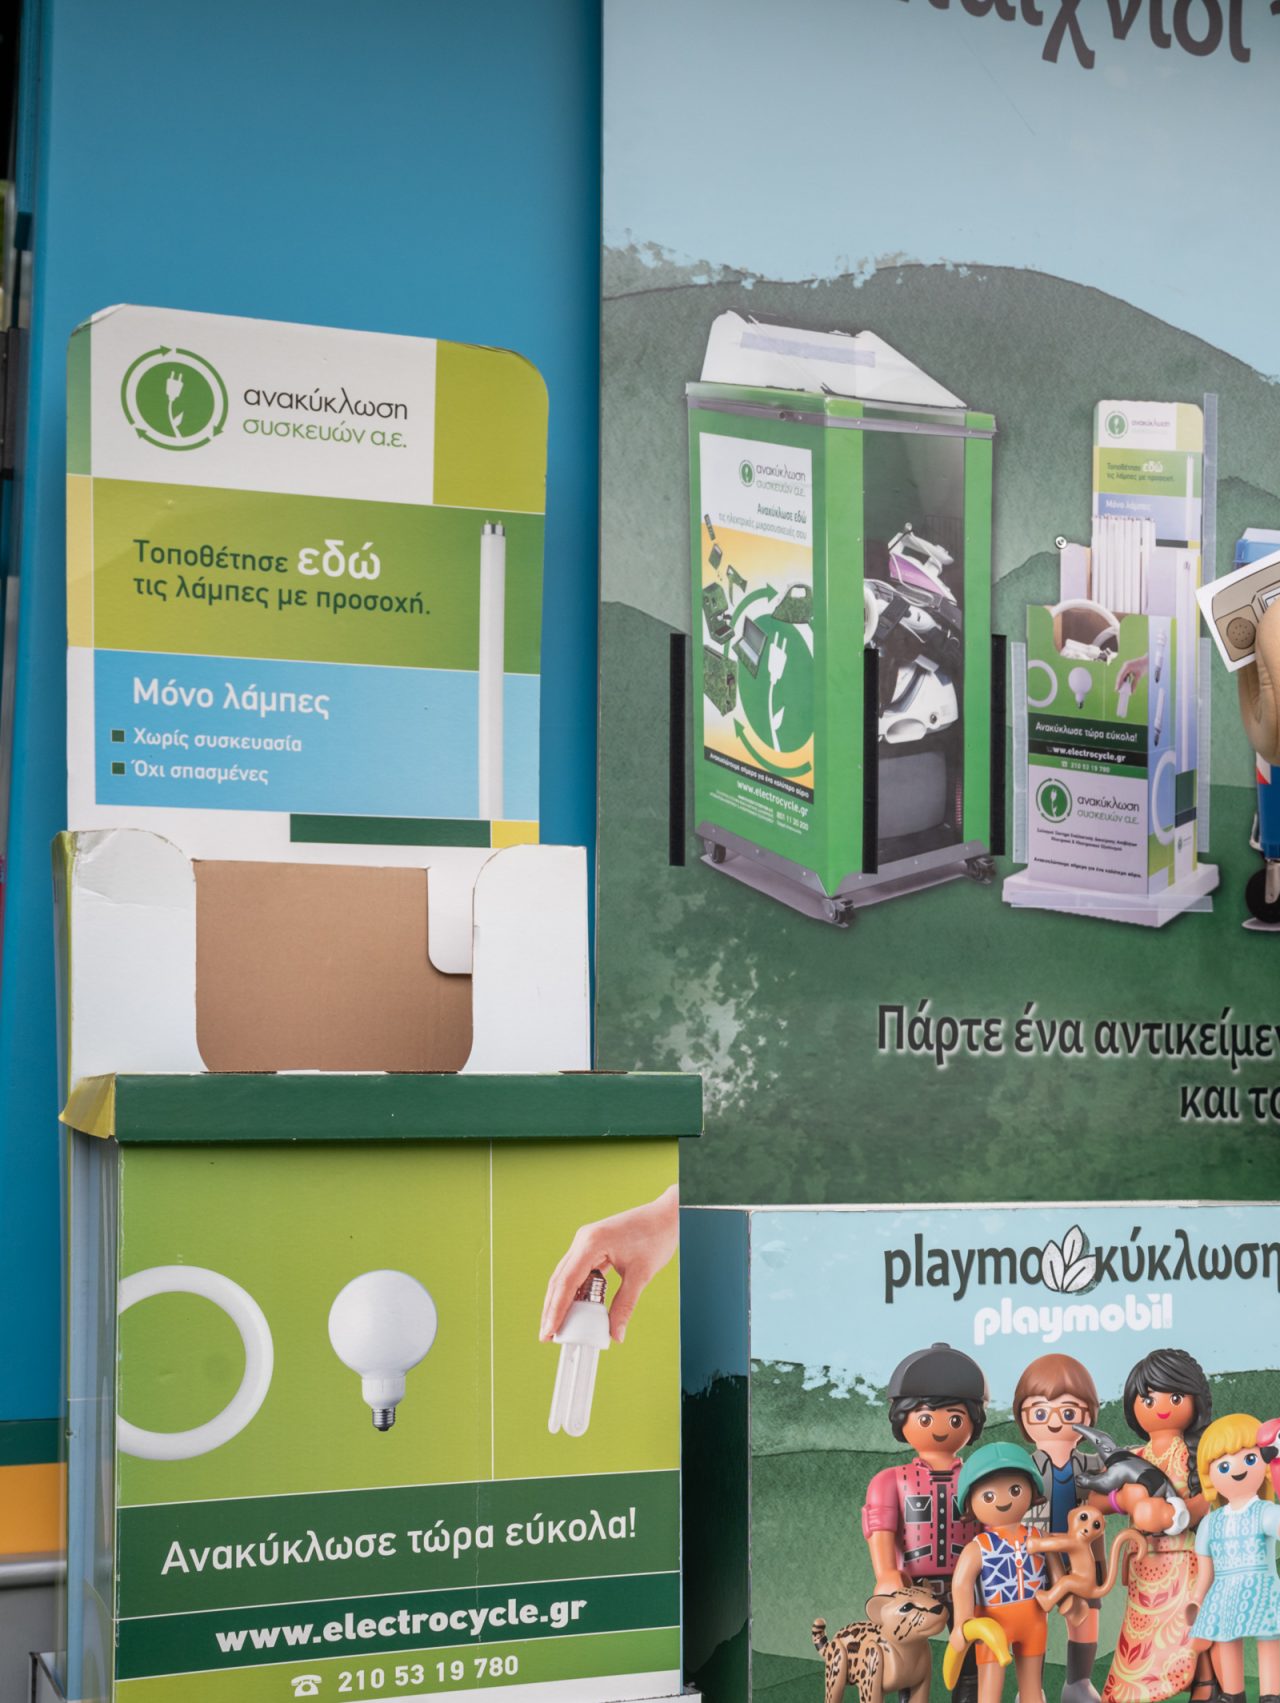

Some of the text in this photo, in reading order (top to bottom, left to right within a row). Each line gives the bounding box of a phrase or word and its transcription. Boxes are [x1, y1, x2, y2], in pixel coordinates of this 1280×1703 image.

[243, 386, 408, 421] ανακύκλωση
[242, 416, 408, 449] συσκευών α.ε.
[756, 464, 806, 483] ανακύκλωση
[133, 539, 381, 581] Τοποθέτησε εδώ
[133, 576, 431, 616] τις λάμπες με προσοχή.
[132, 677, 330, 720] Μόνο λάμπες
[133, 727, 302, 752] Χωρίς συσκευασία
[1035, 722, 1083, 737] Ανακύκλωσε
[1085, 728, 1104, 740] τώρα
[130, 759, 269, 785] Όχι σπασμένες
[1077, 795, 1140, 812] ανακύκλωση
[876, 1000, 1003, 1069] Πάρτε
[1013, 1002, 1084, 1054] ένα
[1180, 1082, 1240, 1121] και
[973, 1292, 1173, 1346] playmobil
[160, 1507, 637, 1577] Ανακύκλωσε τώρα εύκολα!
[215, 1596, 588, 1654] www.electrocycle.gr
[337, 1655, 519, 1692] 210 53 19 780
